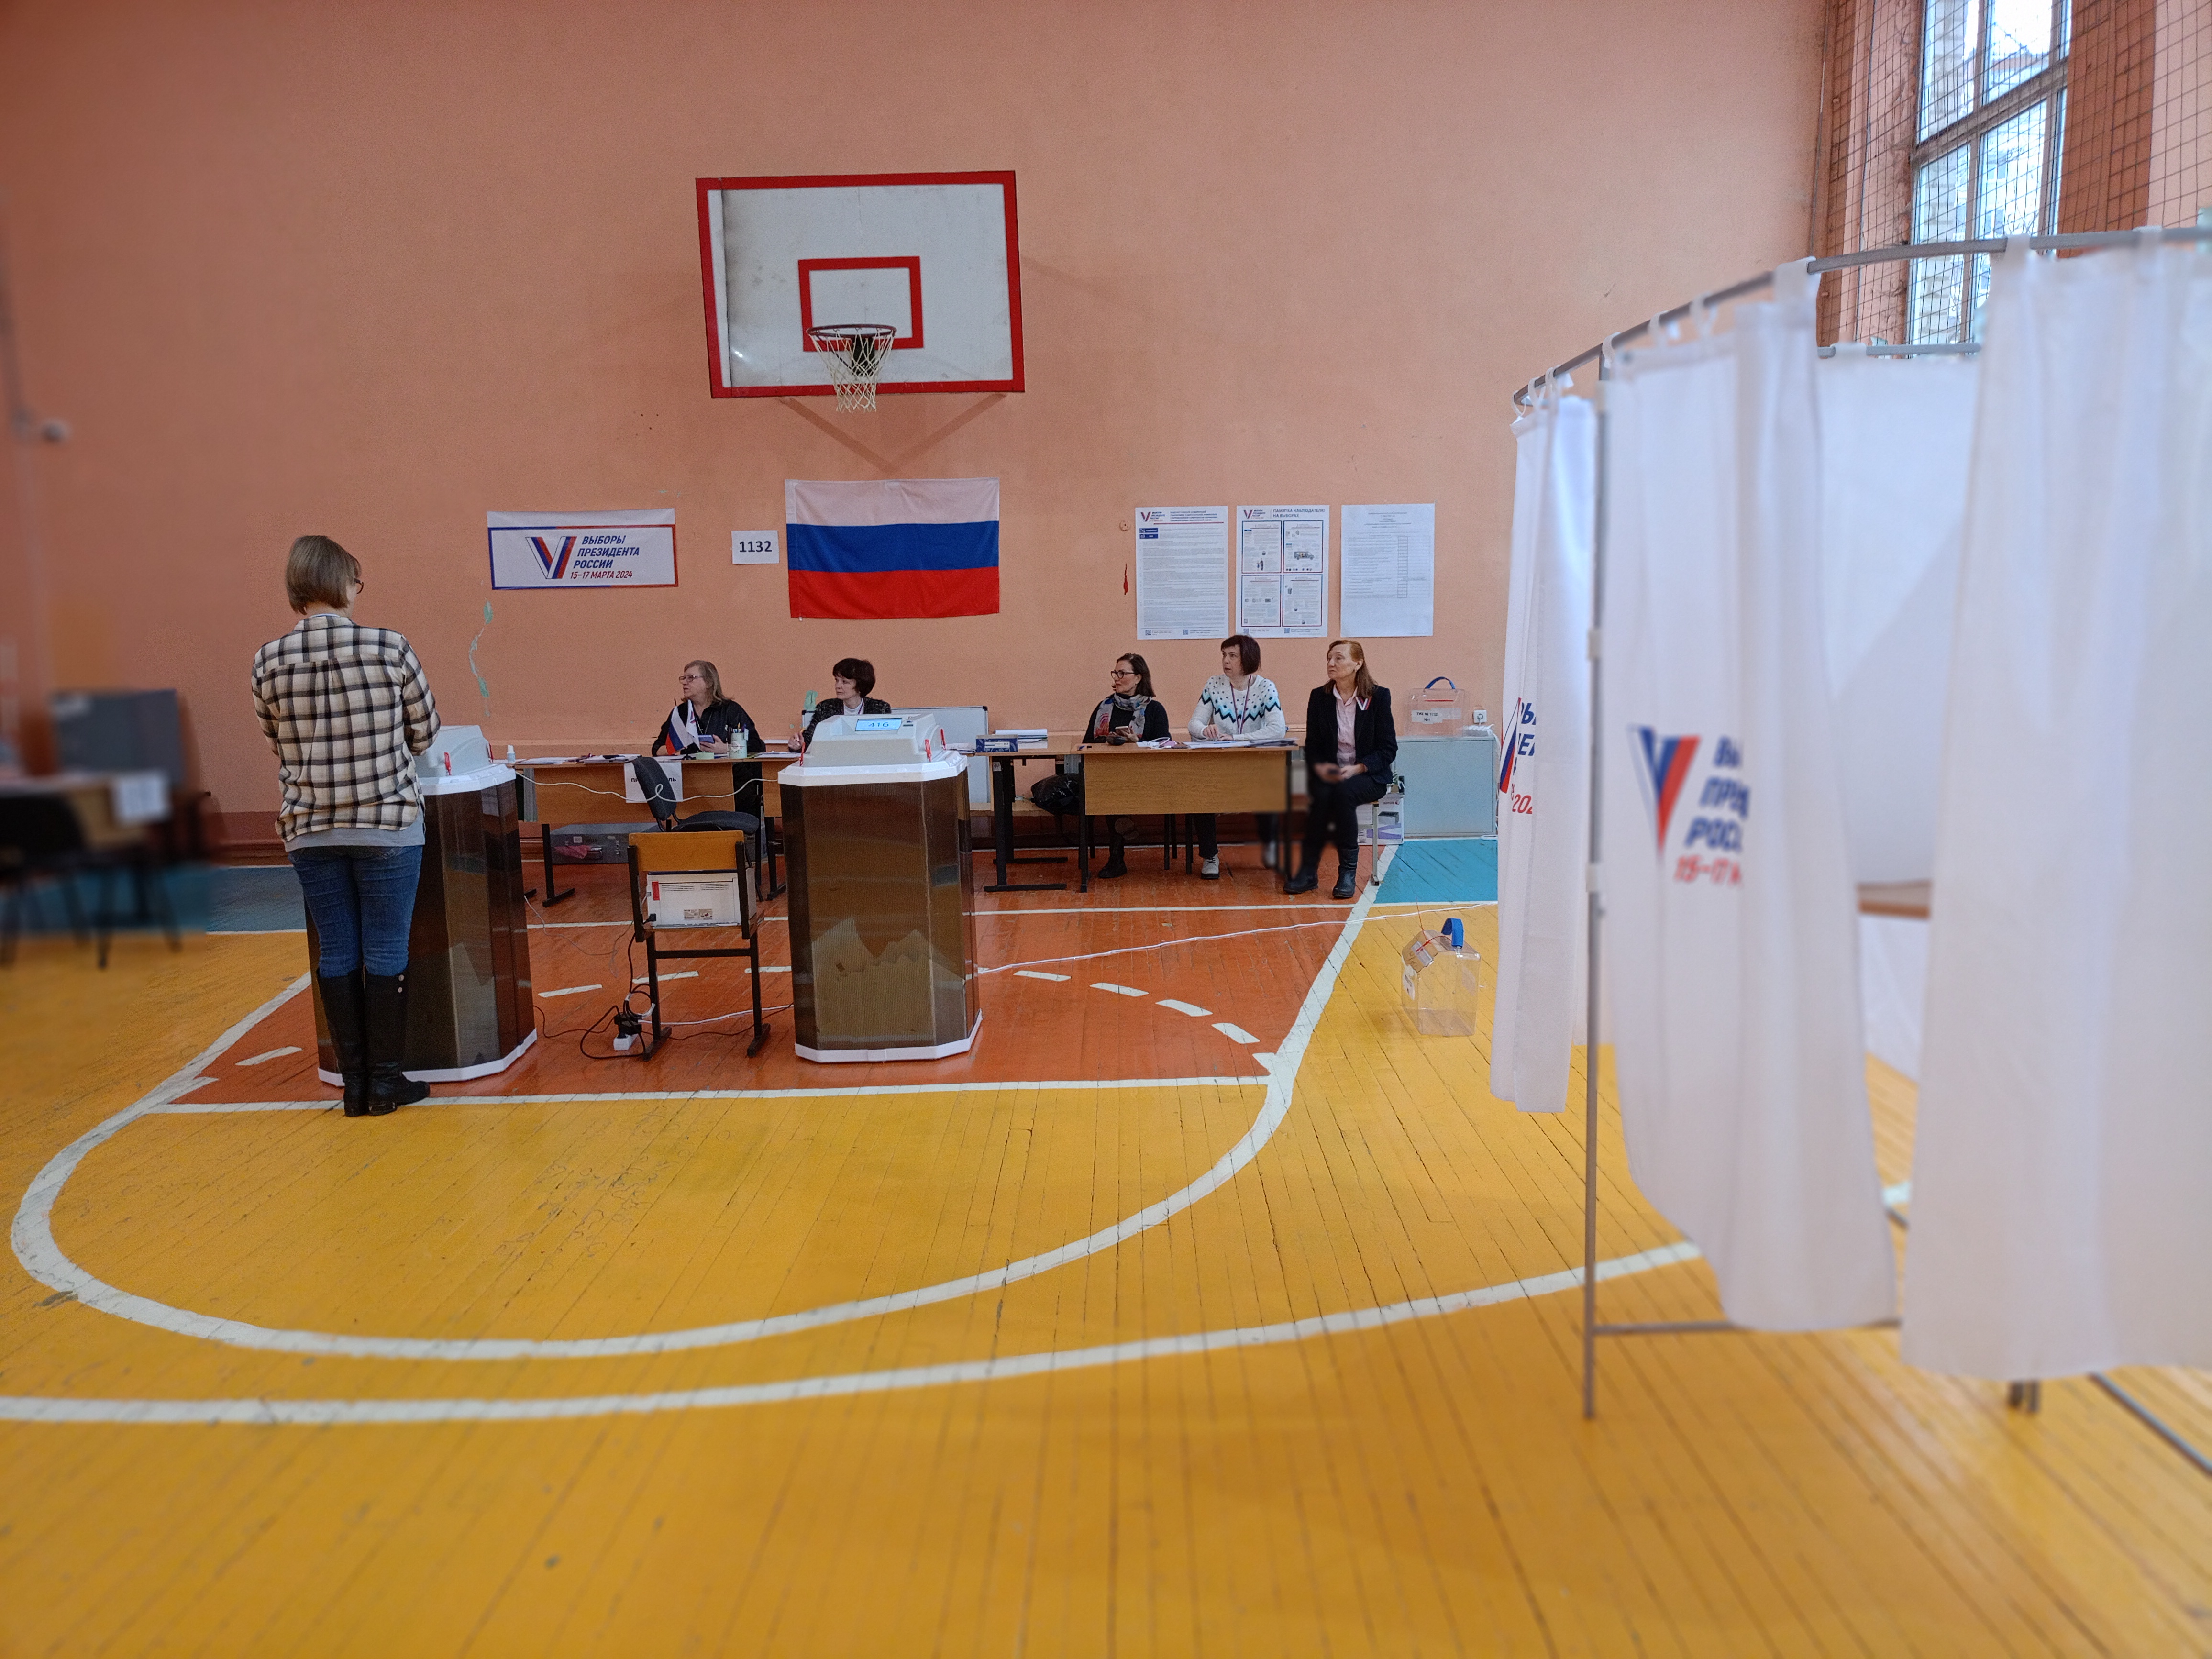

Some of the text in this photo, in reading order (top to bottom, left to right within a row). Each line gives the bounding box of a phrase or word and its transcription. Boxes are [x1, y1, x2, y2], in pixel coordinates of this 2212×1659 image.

[582, 535, 626, 545] ВЫБОРЫ
[577, 547, 640, 557] ПРЕЗИДЕНТА
[739, 541, 772, 553] 1132
[573, 559, 614, 569] РОССИИ
[590, 571, 614, 579] МАРТА
[615, 570, 633, 578] 2024
